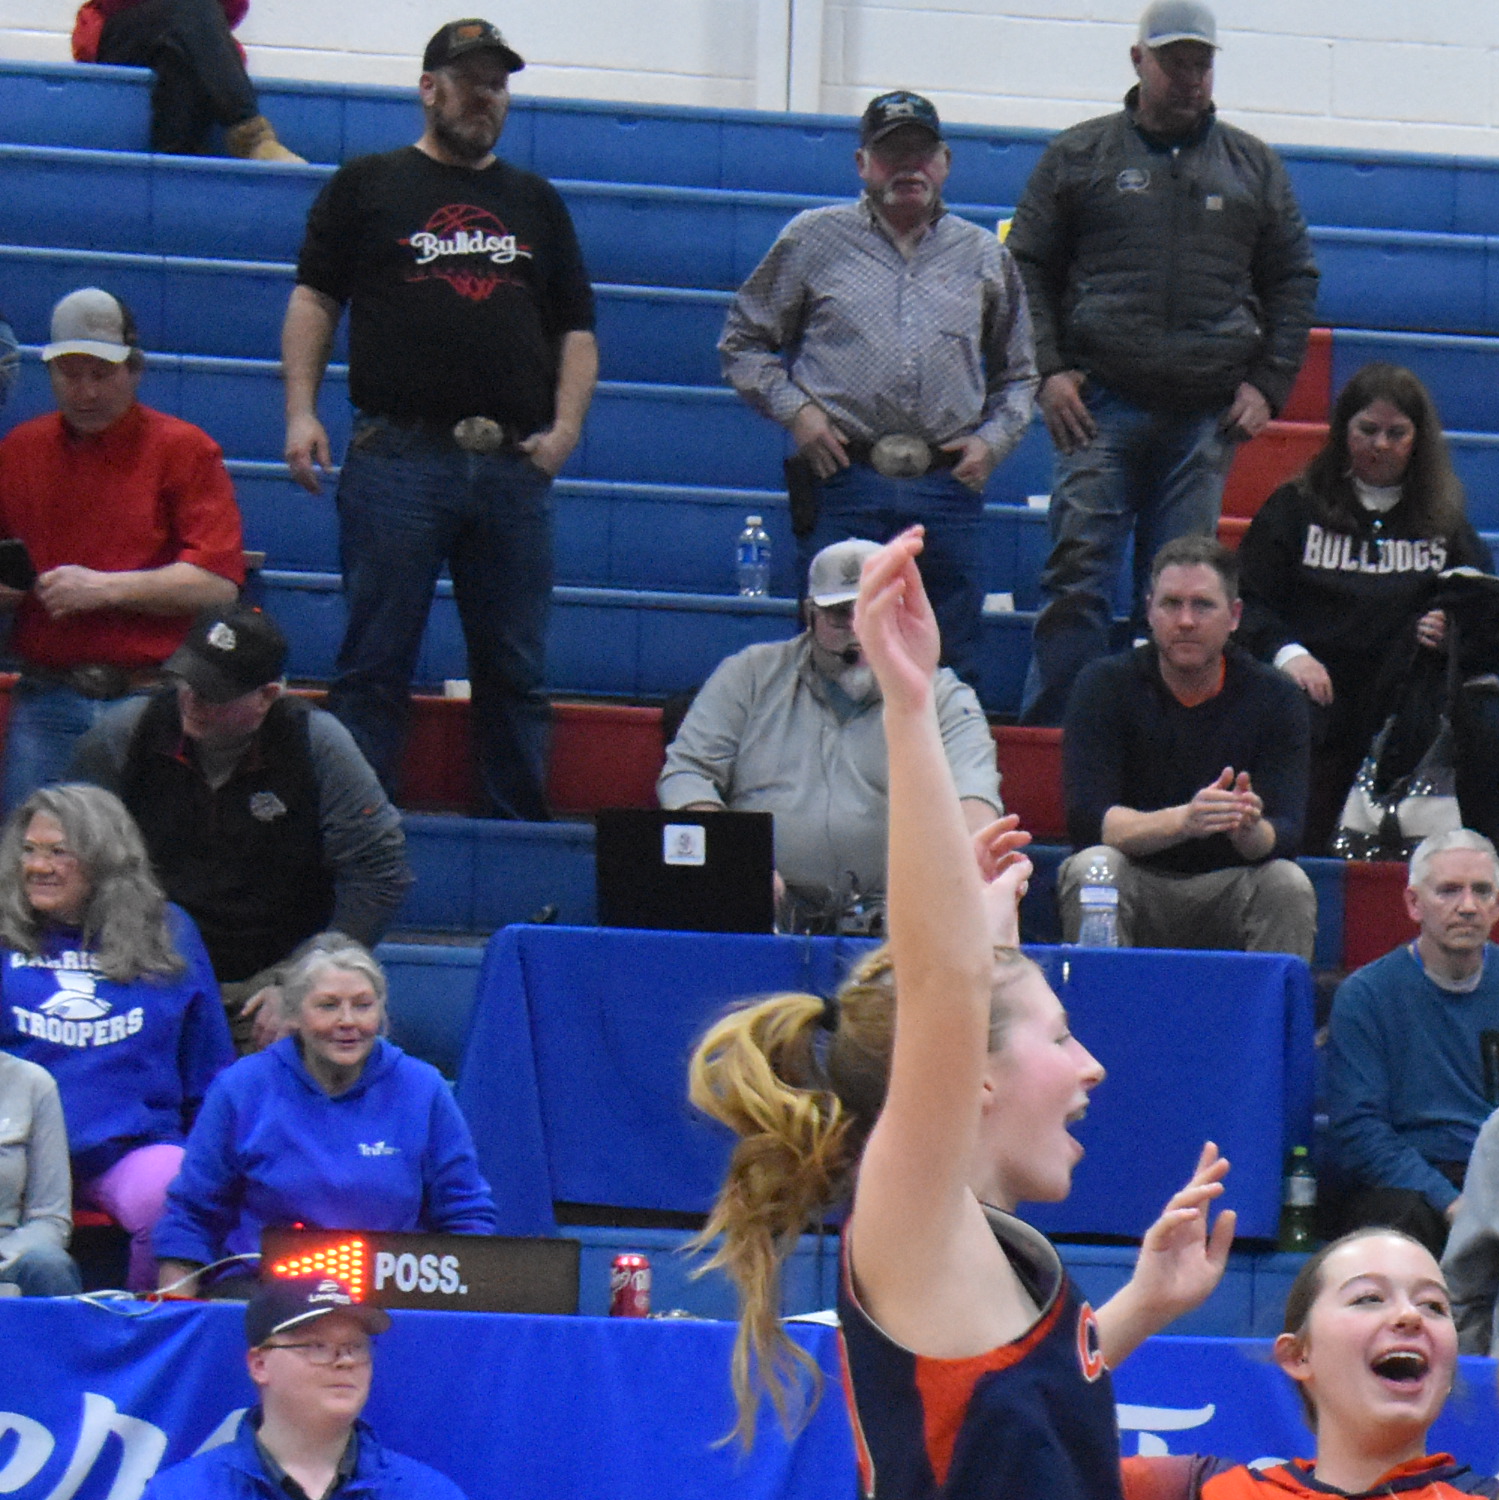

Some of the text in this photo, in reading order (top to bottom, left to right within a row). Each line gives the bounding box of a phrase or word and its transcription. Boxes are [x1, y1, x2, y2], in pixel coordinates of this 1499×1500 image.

[410, 230, 533, 264] Bulldog
[1302, 523, 1448, 574] BULLDOGS
[11, 1005, 144, 1047] TROOPERS
[375, 1252, 468, 1295] POSS.
